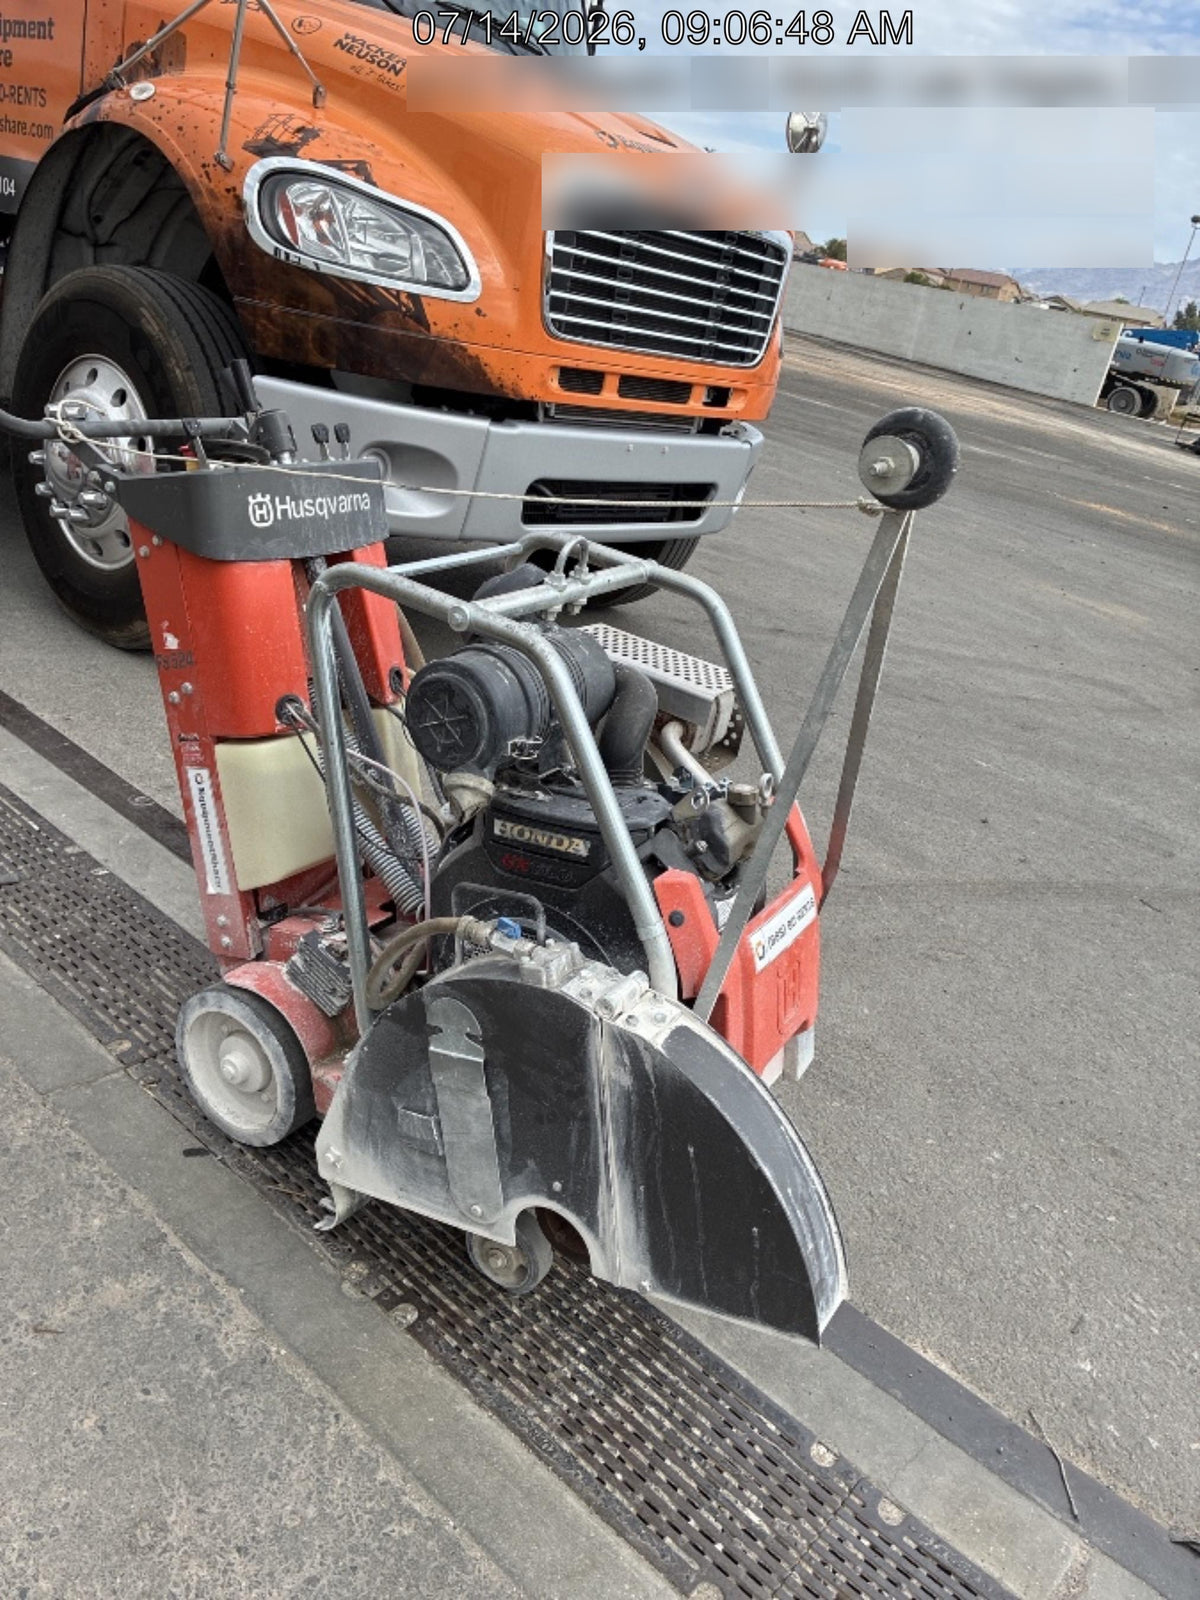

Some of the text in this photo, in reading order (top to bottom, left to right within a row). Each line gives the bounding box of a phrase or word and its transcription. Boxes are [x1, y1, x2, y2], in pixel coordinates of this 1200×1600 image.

[333, 38, 405, 77] NEUSON
[344, 32, 407, 67] WACKER
[275, 492, 371, 521] Husqvarna
[494, 818, 591, 858] HONDA
